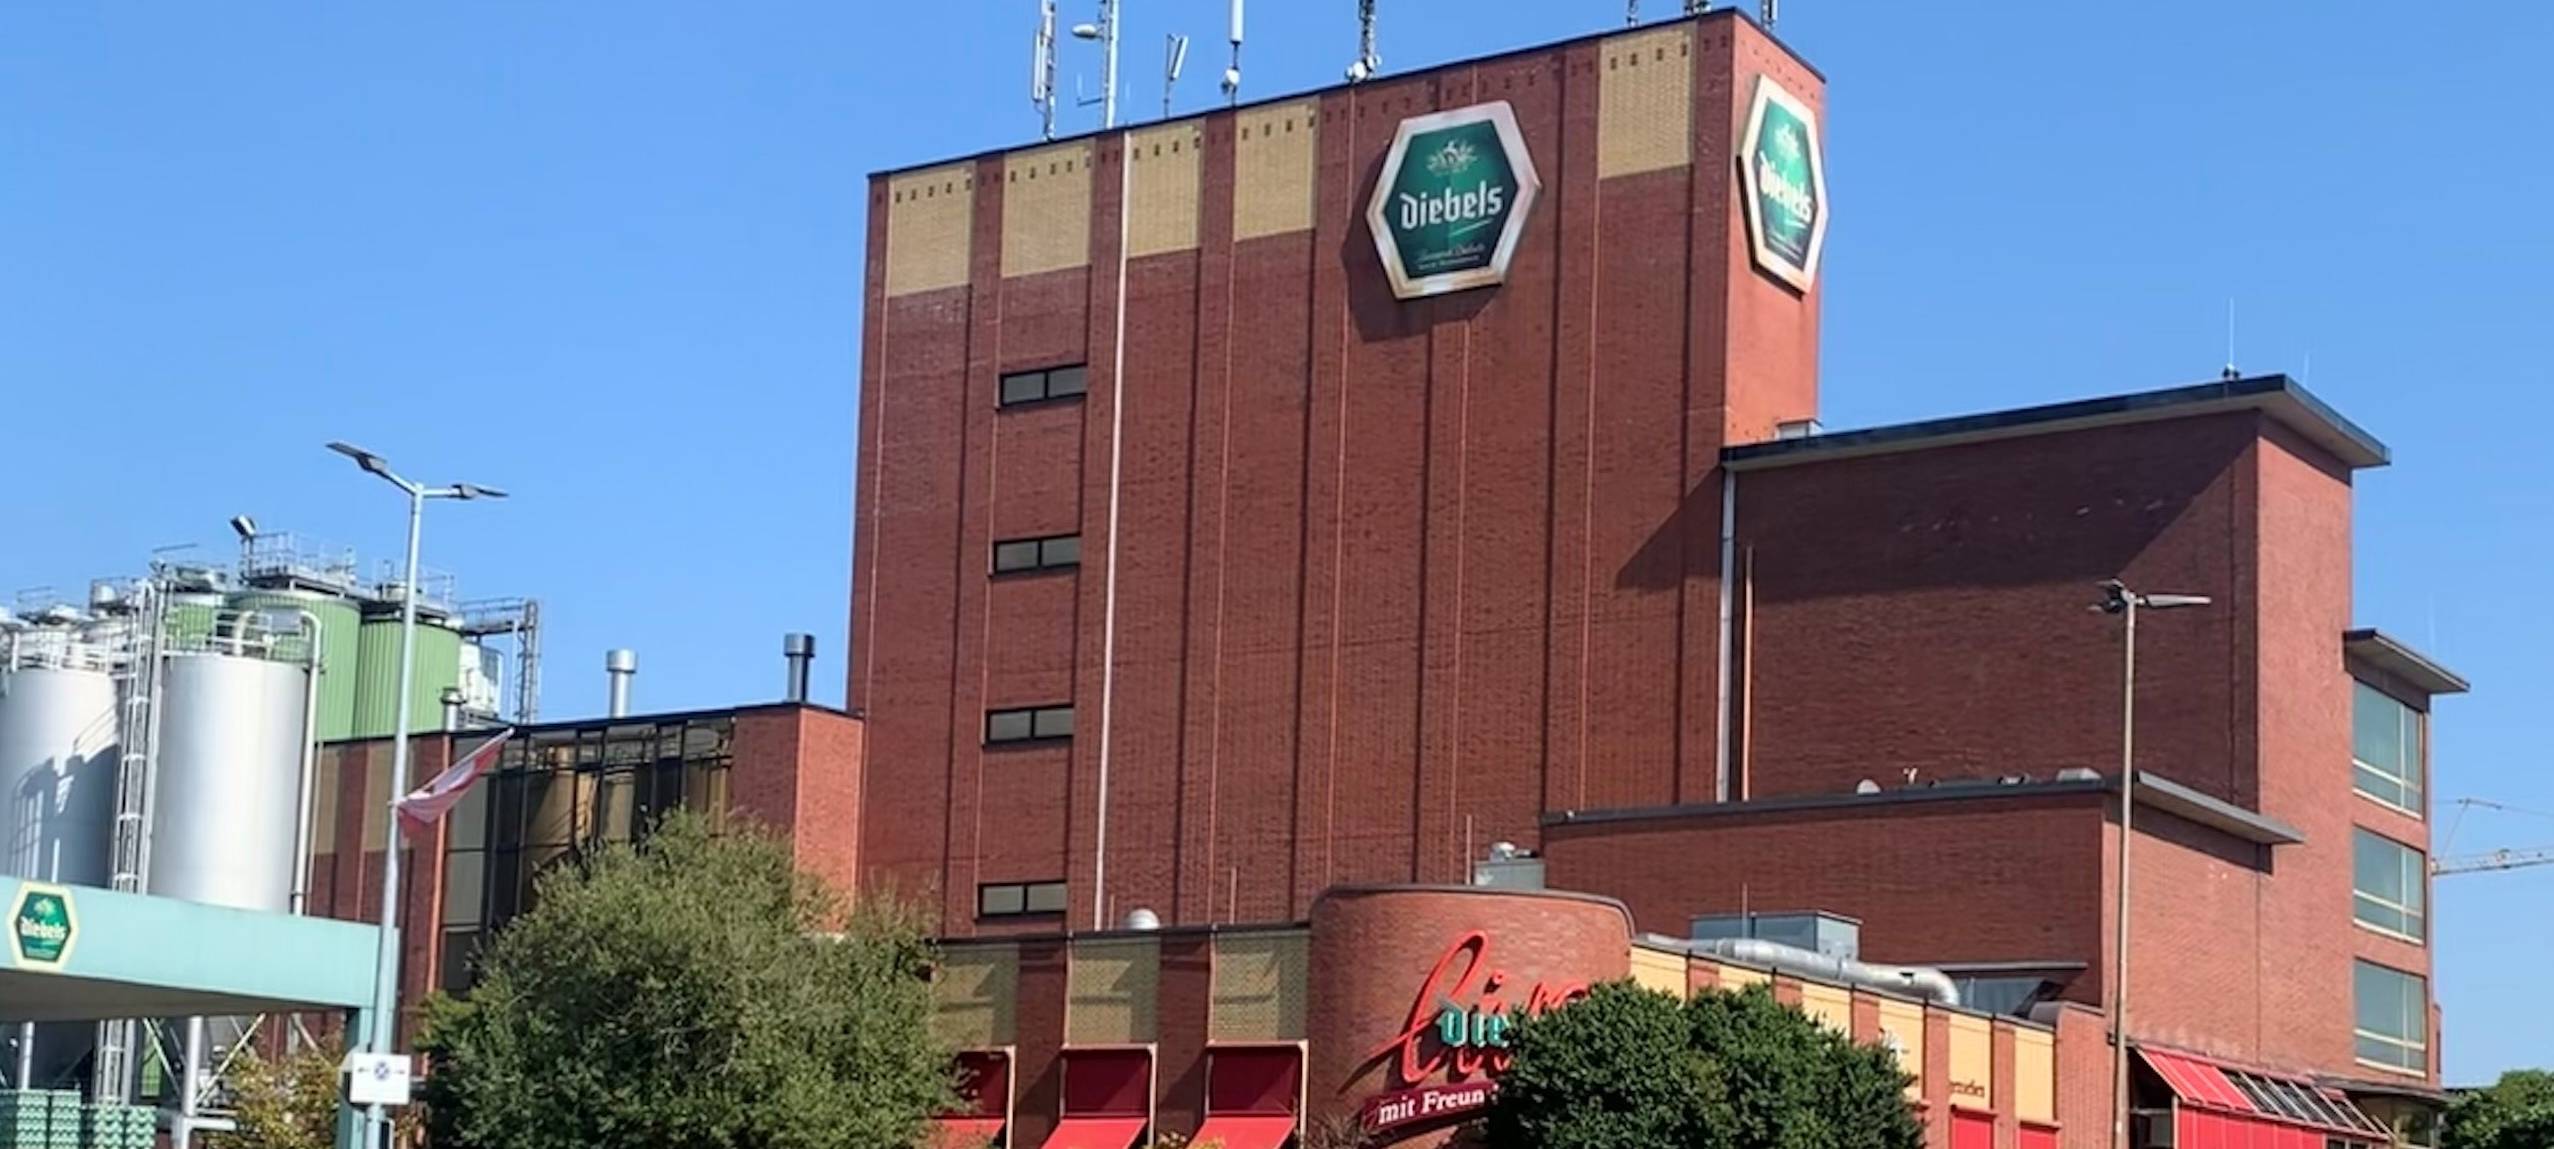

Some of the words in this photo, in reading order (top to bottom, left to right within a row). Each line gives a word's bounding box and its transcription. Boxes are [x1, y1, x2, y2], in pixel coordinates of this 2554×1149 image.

[1400, 180, 1503, 230] Diebels
[1378, 1095, 1416, 1126] mit
[1420, 1083, 1499, 1115] Freun
